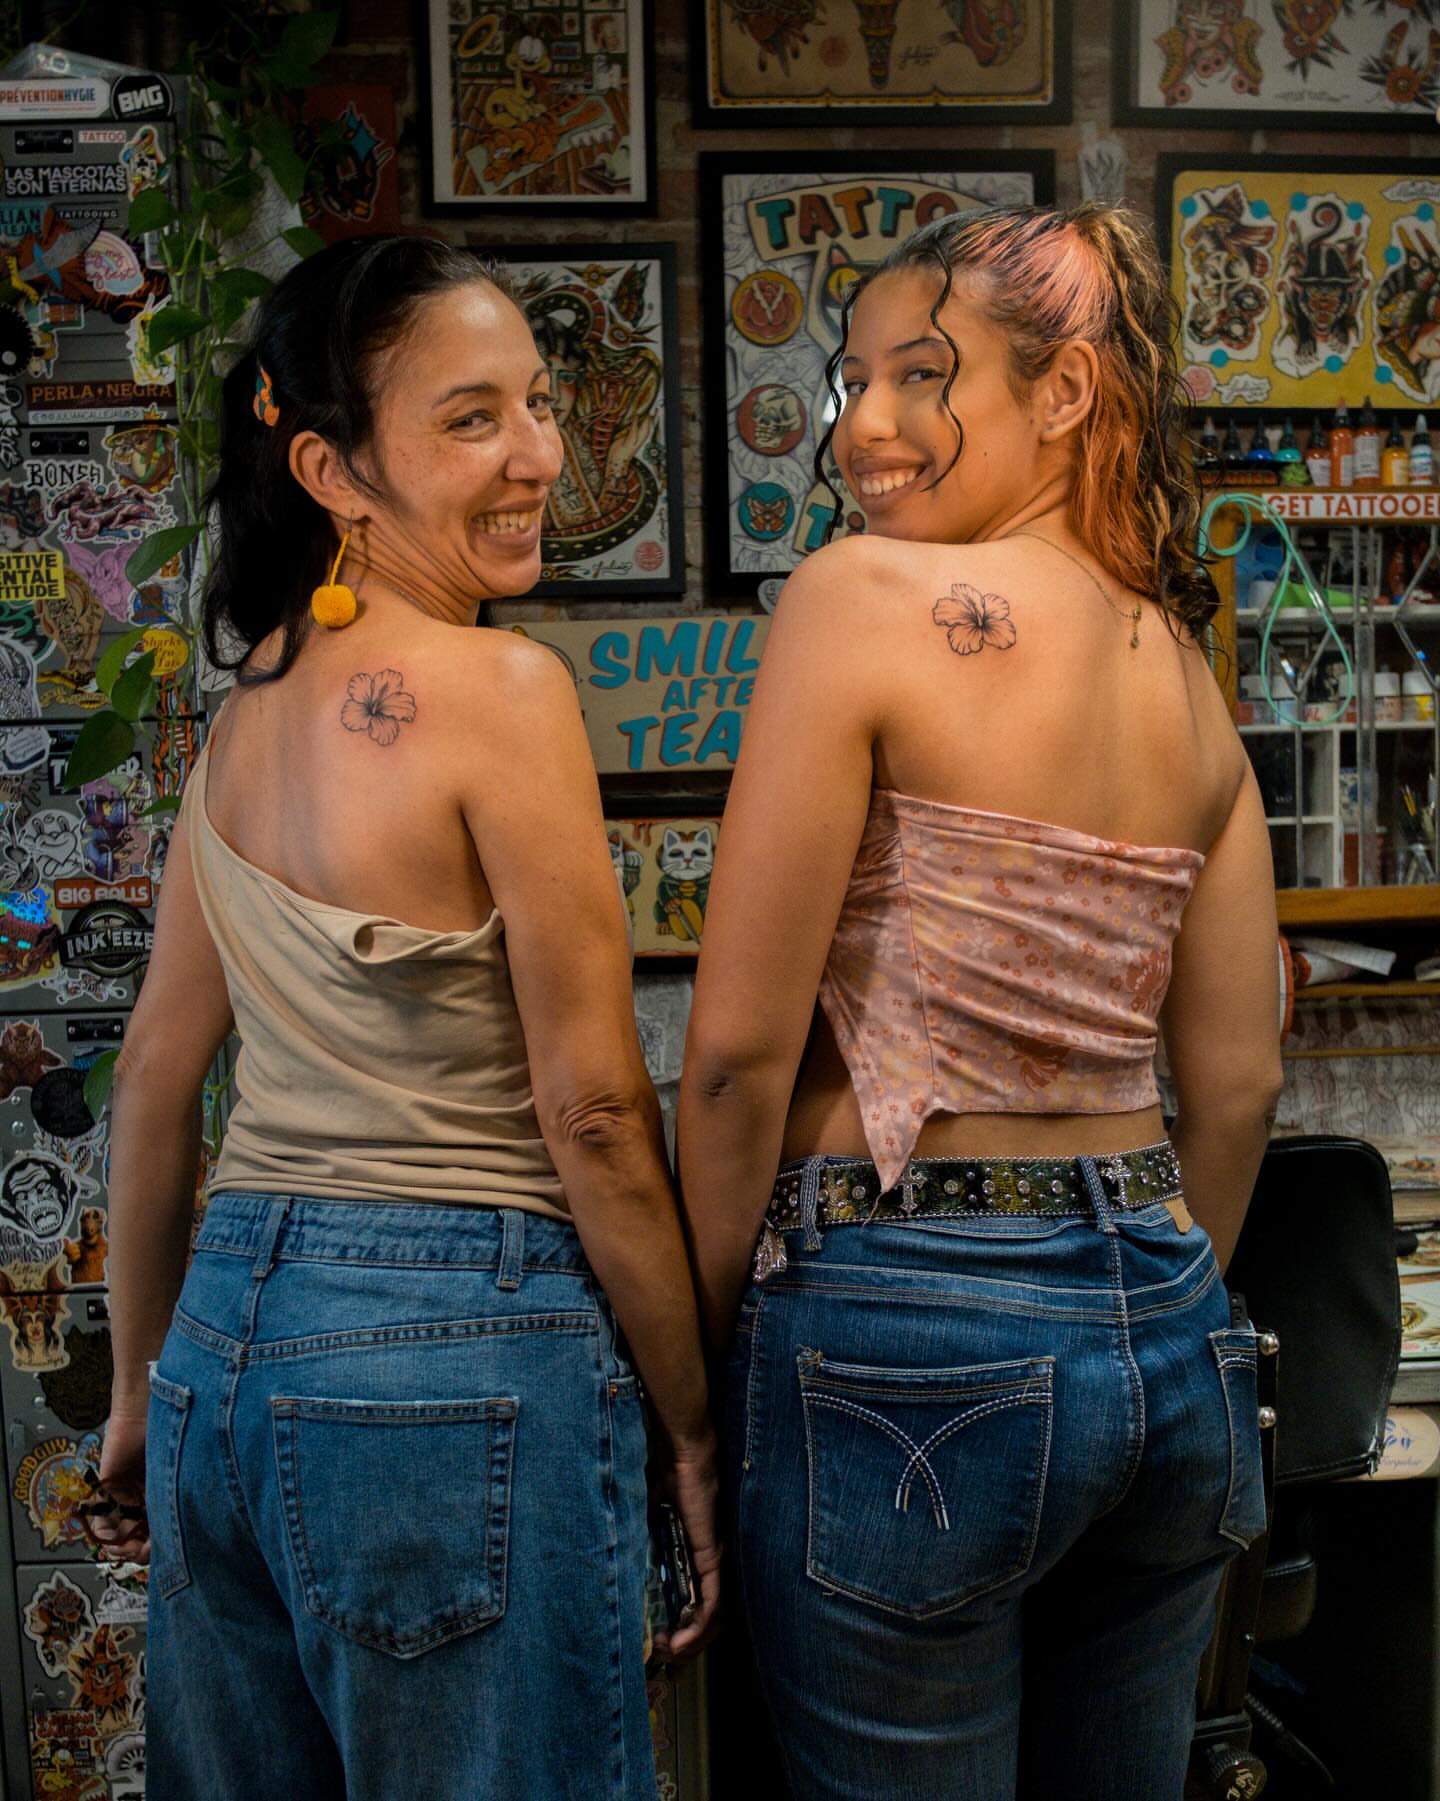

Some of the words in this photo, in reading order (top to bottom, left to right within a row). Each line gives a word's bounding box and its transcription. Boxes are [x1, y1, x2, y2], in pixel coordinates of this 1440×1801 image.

[82, 131, 124, 141] TATTOO
[5, 167, 34, 181] LAS
[38, 164, 126, 180] MASCOTAS
[7, 180, 43, 195] SON
[50, 177, 127, 192] ETERNAS
[59, 209, 118, 218] TATTOOING
[756, 186, 959, 250] TATTO
[31, 384, 94, 403] PERLA
[105, 382, 173, 398] NEGRA
[1268, 495, 1313, 516] GET
[1323, 494, 1440, 516] TATTOOE
[0, 570, 58, 584] NTAL
[588, 619, 760, 689] SMIL
[661, 676, 756, 712] AFTE
[617, 710, 741, 770] TEA
[58, 886, 92, 905] BIG
[66, 932, 108, 960] INK
[15, 1455, 39, 1500] GOOD
